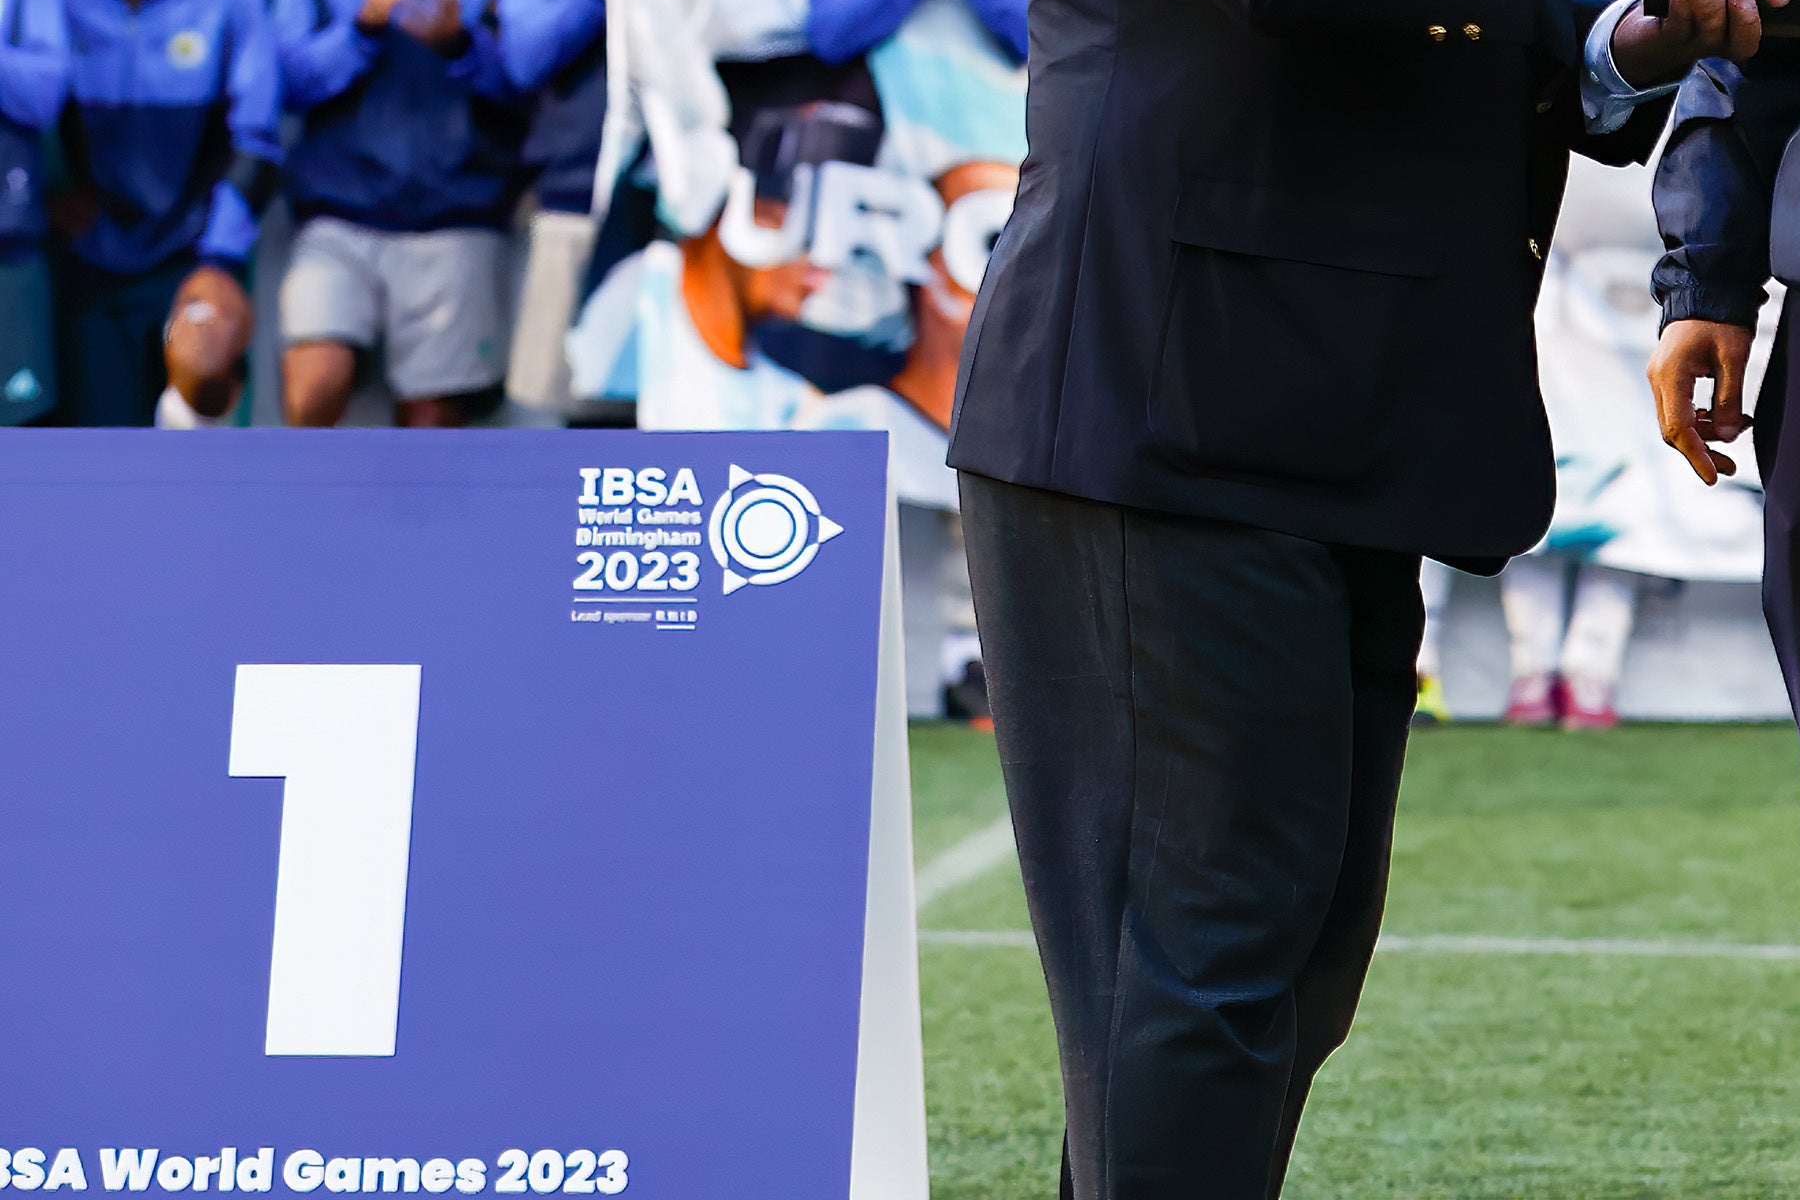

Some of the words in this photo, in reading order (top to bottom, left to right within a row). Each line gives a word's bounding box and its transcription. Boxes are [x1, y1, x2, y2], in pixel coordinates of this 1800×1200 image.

[577, 467, 704, 507] IBSA
[578, 507, 633, 525] World
[636, 507, 702, 525] Games
[575, 526, 702, 551] Birmingham
[572, 551, 700, 591] 2023
[228, 664, 422, 1056] 1
[100, 1146, 274, 1192] World
[283, 1149, 488, 1194] Games
[496, 1149, 630, 1195] 2023
